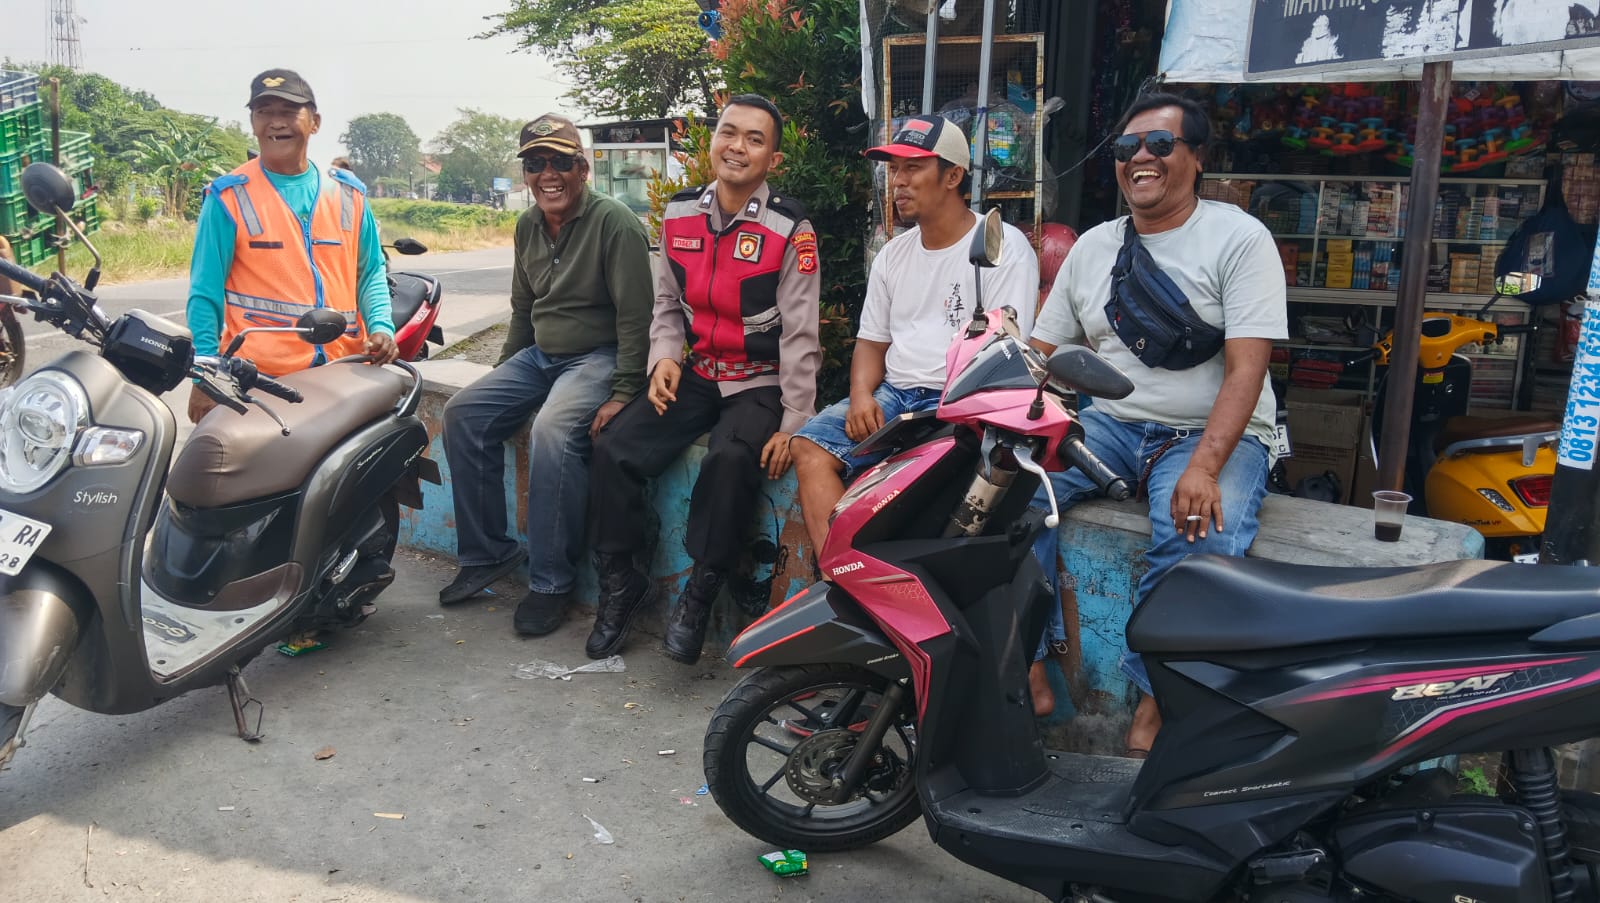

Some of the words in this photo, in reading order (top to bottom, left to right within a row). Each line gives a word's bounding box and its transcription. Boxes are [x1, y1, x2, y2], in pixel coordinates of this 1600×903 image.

[140, 336, 174, 354] HONDA
[1576, 362, 1600, 407] 1234
[1568, 413, 1598, 463] 0813
[73, 491, 118, 506] Stylish
[871, 489, 901, 513] HONDA
[13, 524, 42, 548] RA
[0, 553, 20, 568] 28
[832, 561, 865, 576] HONDA
